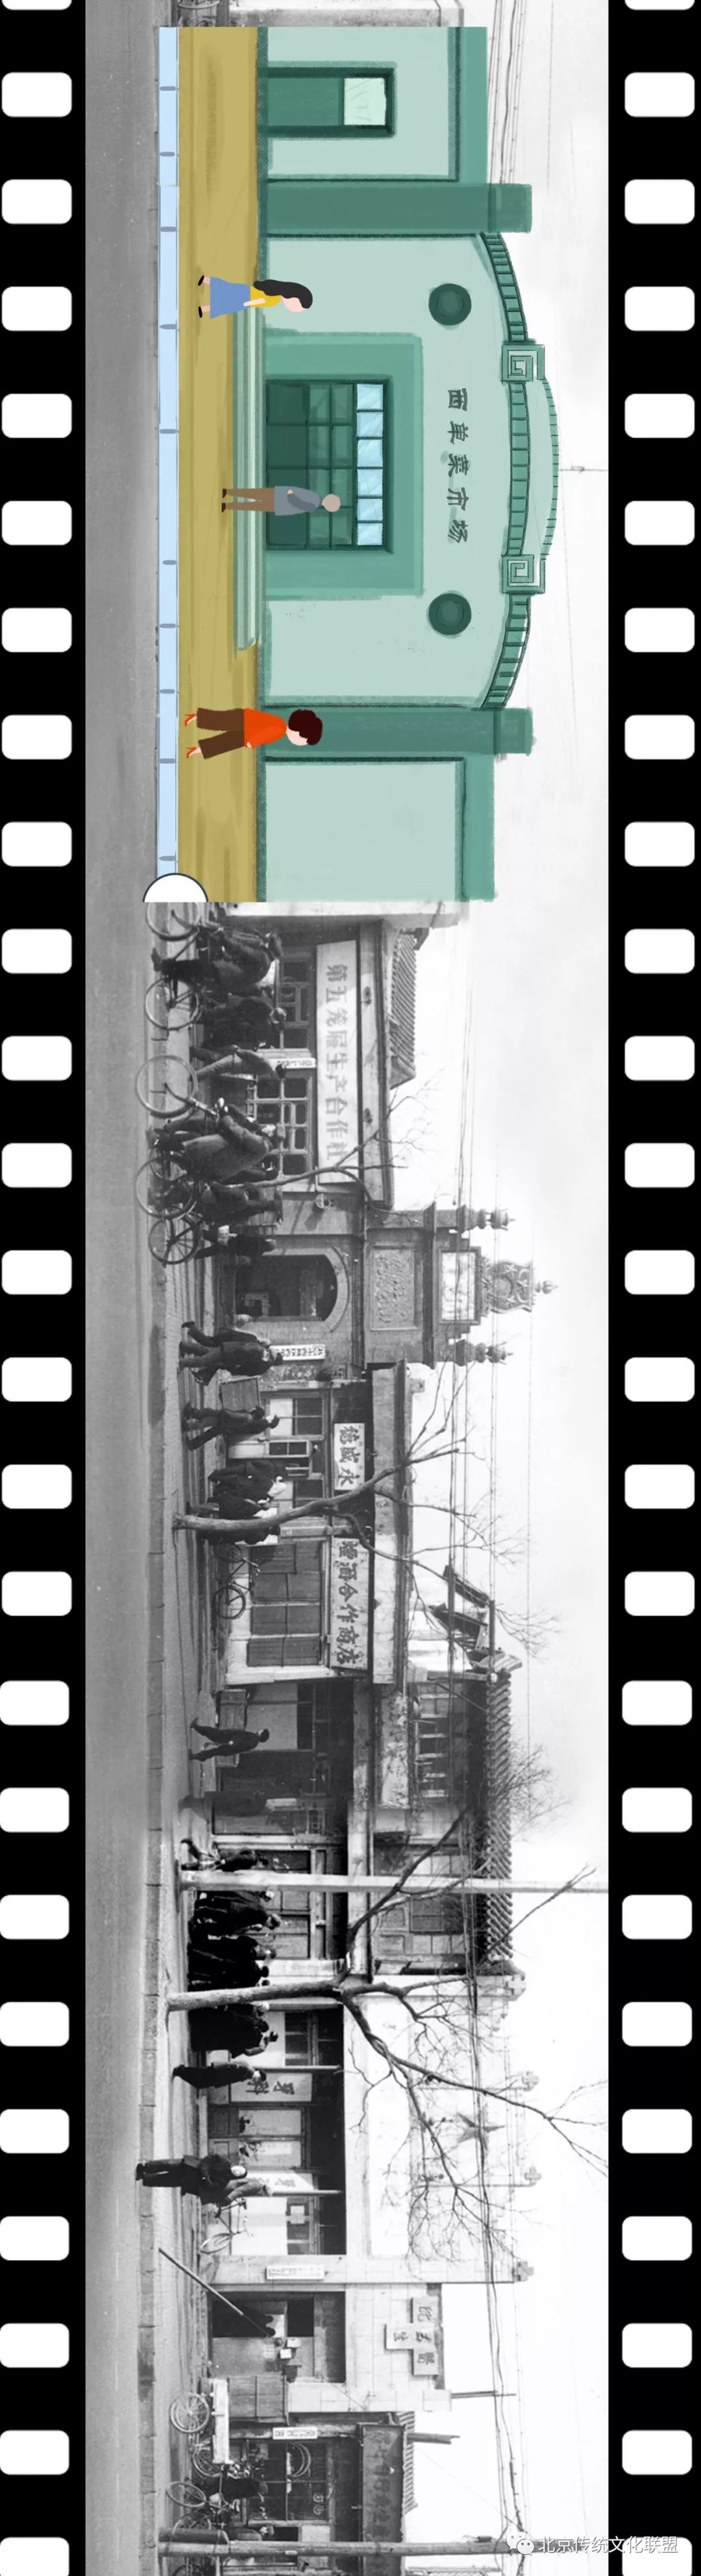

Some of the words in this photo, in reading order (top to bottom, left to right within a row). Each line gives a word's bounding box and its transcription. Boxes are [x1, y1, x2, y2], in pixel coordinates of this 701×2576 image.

[447, 388, 469, 543] 西单菜市场
